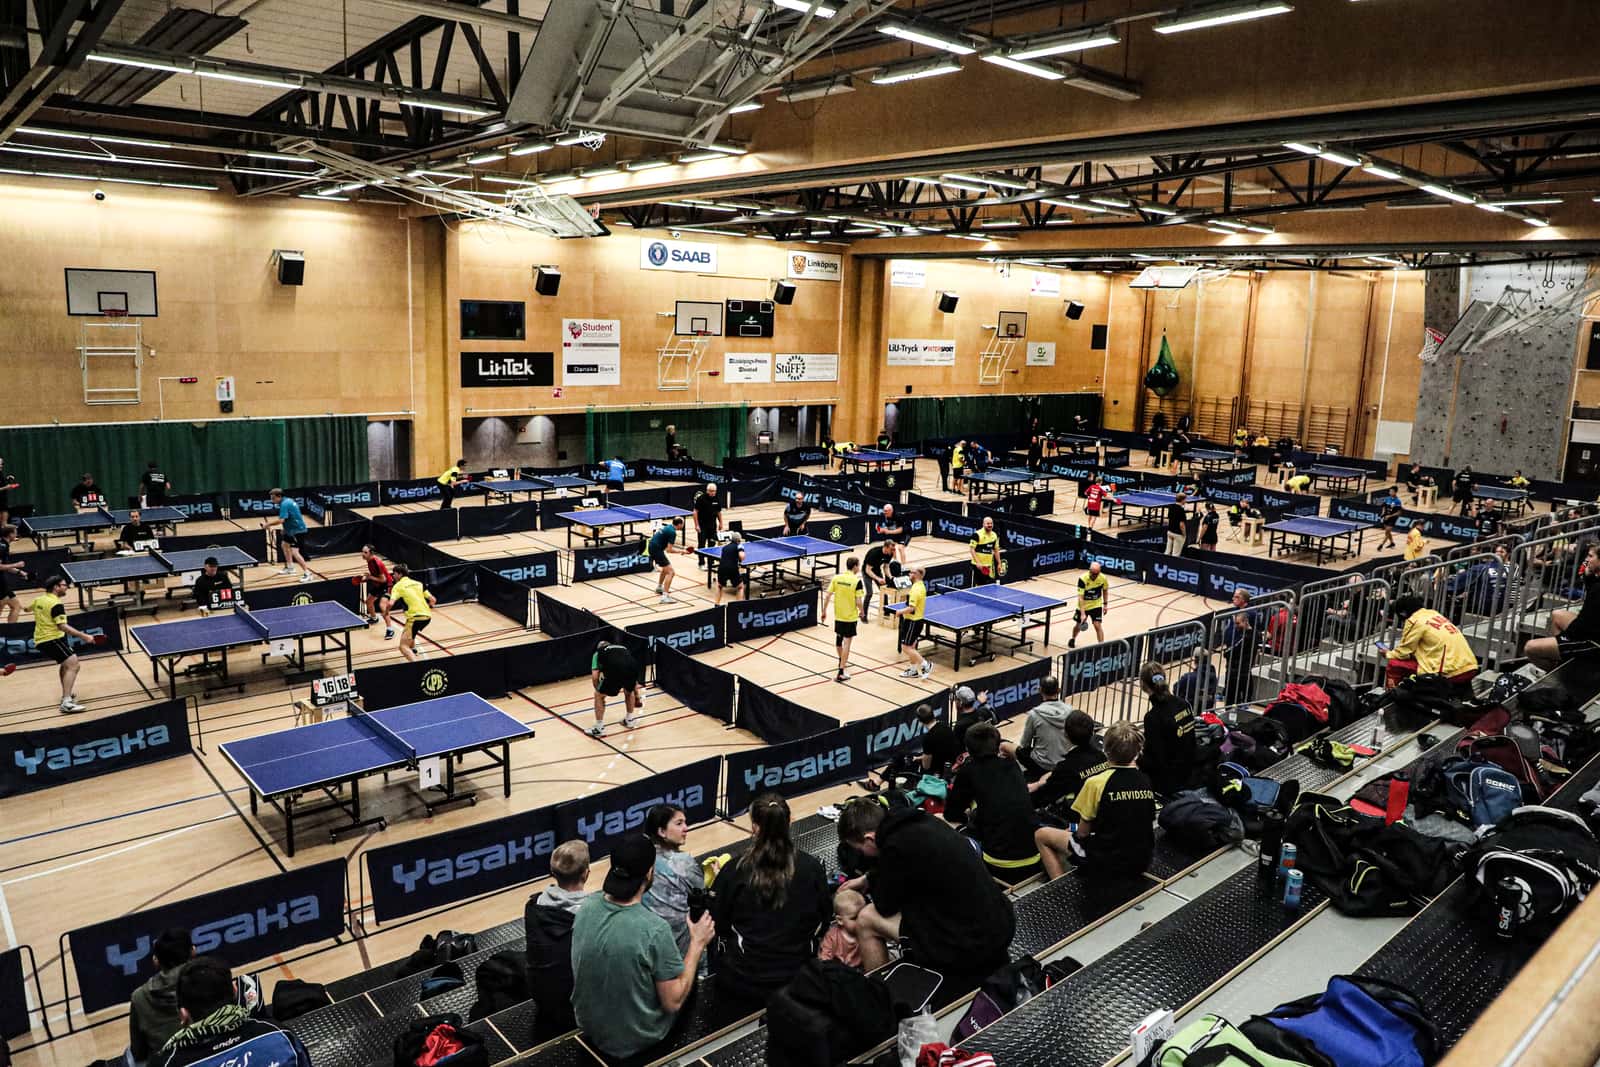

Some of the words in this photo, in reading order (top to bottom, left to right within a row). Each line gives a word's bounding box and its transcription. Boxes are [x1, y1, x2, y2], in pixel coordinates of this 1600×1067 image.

[671, 250, 711, 263] SAAB
[808, 260, 838, 270] Linköping
[582, 323, 612, 332] Student
[889, 344, 919, 353] LiU-Tryck
[478, 358, 535, 376] LinTek
[590, 468, 636, 480] Yasa
[646, 465, 694, 476] Yasaka
[1206, 487, 1254, 502] Yasaka
[238, 497, 304, 511] Yasa
[825, 495, 862, 513] Yasaka
[1337, 505, 1384, 522] Yasak
[939, 519, 976, 536] Yasa
[1032, 550, 1074, 567] Yasaka
[500, 564, 547, 581] saka
[212, 592, 219, 603] 6
[221, 591, 232, 600] 11
[235, 591, 242, 600] 8
[738, 604, 809, 629] Yasaka
[1070, 652, 1130, 677] Yasaka
[322, 681, 334, 694] 16
[337, 678, 349, 691] 18
[973, 678, 1041, 709] asaka
[14, 724, 170, 775] Yasaka
[425, 767, 432, 779] 1
[744, 746, 851, 791] Yasaka
[577, 784, 703, 842] Yaska
[392, 830, 556, 893] Yasaka
[106, 895, 320, 975] Ysaka
